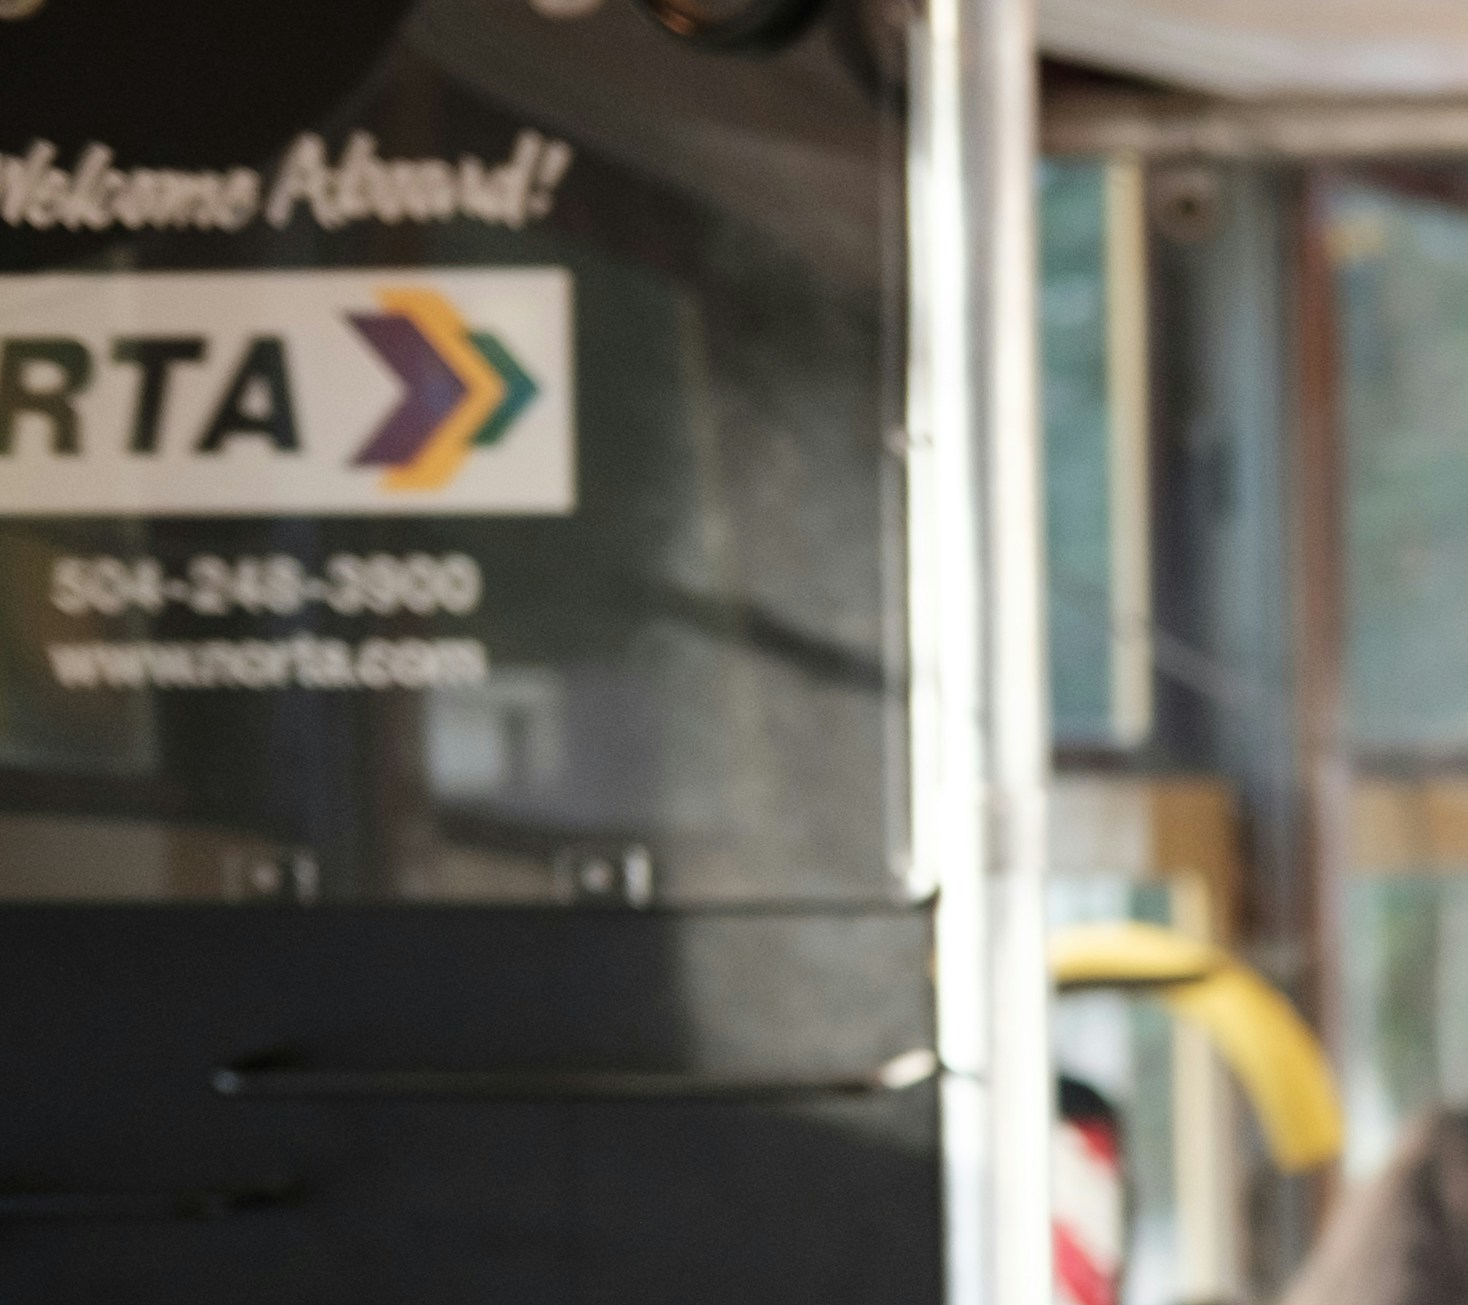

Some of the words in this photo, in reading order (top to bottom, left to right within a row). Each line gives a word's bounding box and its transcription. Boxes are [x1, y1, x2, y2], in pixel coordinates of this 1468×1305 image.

[266, 130, 571, 231] Aboard!
[0, 334, 301, 456] RTA
[48, 632, 486, 690] www.norta.com
